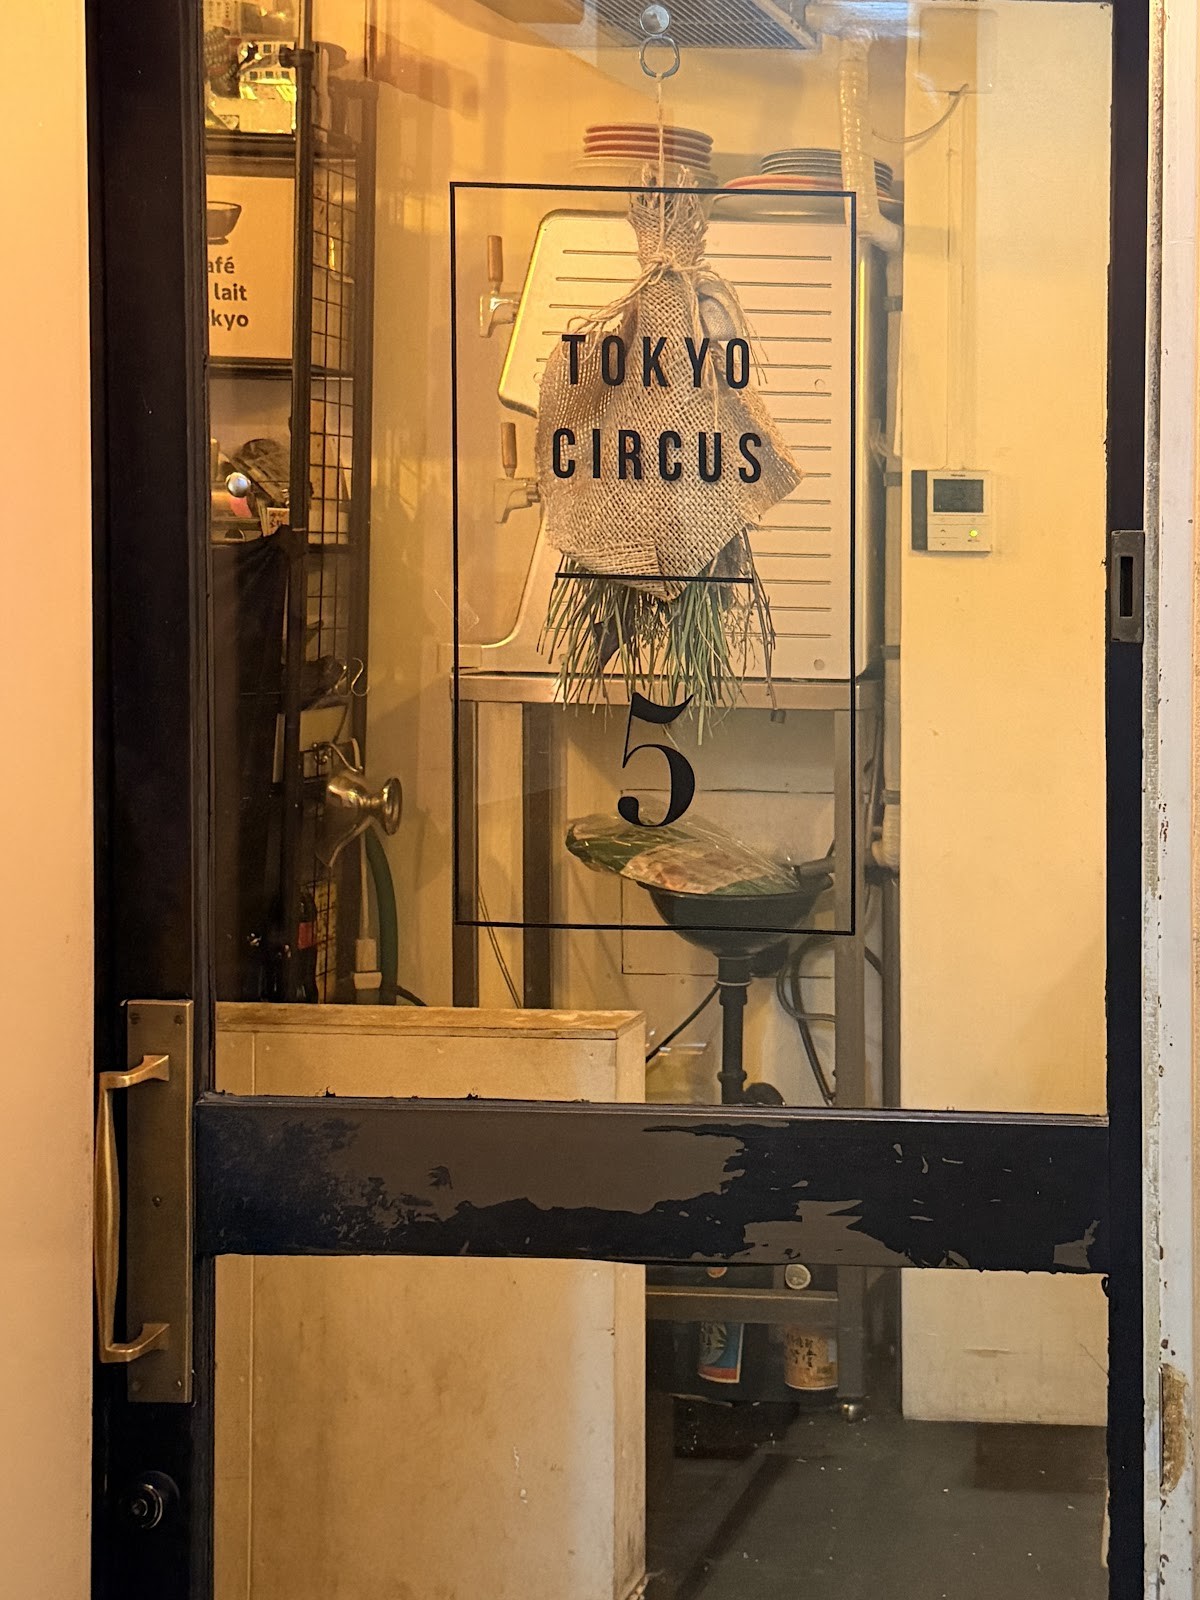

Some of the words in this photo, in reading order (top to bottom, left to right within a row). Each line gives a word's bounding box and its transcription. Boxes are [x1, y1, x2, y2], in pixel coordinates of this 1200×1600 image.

[214, 283, 247, 301] lait
[208, 309, 249, 331] kyo
[561, 334, 751, 389] TOKYO
[552, 428, 762, 483] CIRCUS
[617, 691, 696, 828] 5
